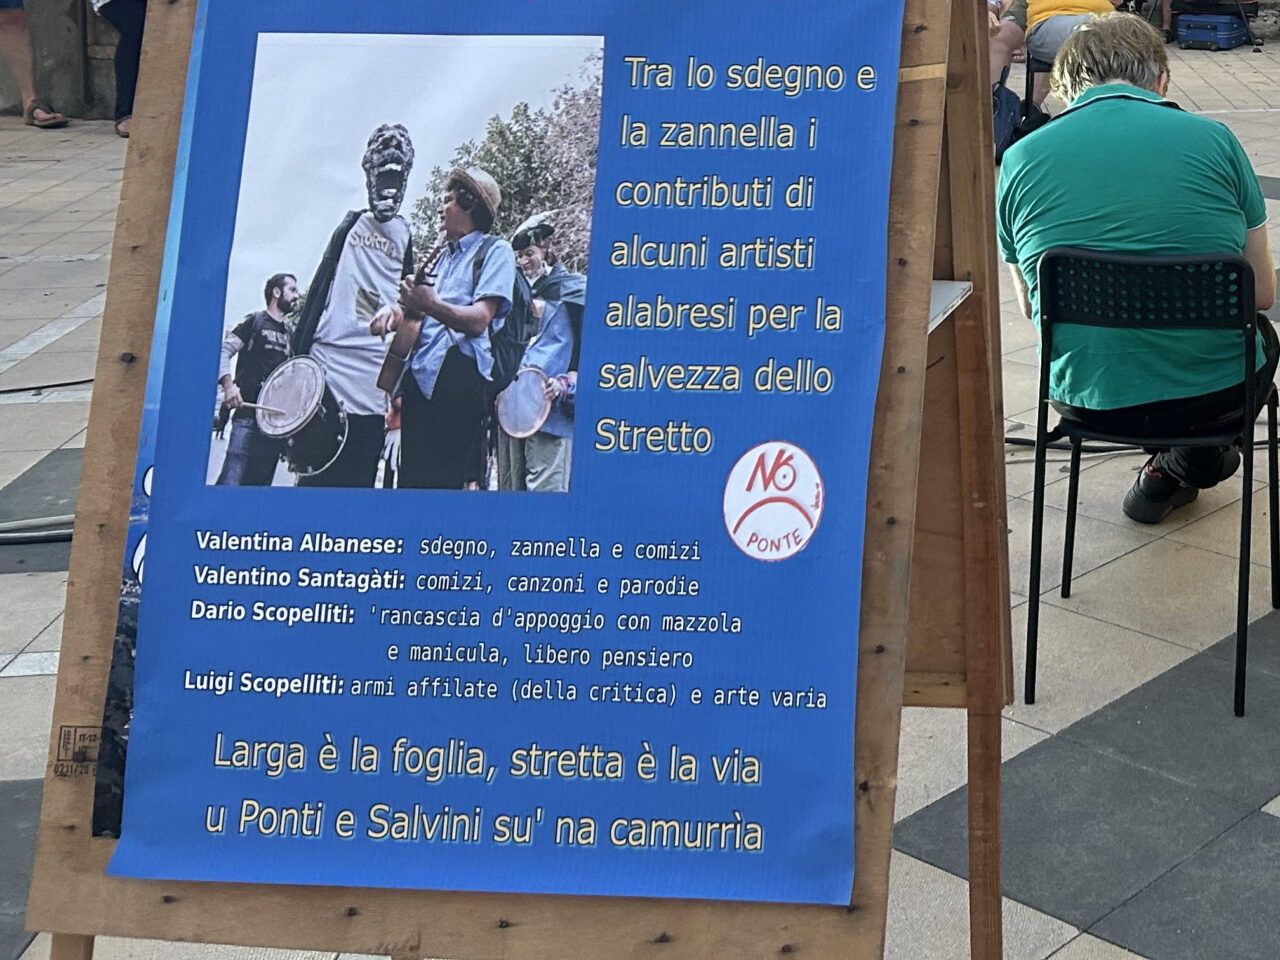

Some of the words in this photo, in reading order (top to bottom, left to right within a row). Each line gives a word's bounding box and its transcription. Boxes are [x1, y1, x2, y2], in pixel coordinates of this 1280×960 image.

[624, 57, 673, 88] Tra
[687, 56, 715, 88] lo
[726, 57, 845, 97] sdegno
[856, 65, 877, 90] e
[620, 114, 648, 147] la
[659, 115, 795, 149] zannella
[807, 117, 818, 149] i
[615, 174, 774, 208] contributi
[784, 175, 816, 209] di
[609, 234, 708, 268] alcuni
[718, 236, 816, 270] artisti
[605, 294, 737, 330] alabresi
[747, 304, 805, 338] per
[814, 297, 842, 331] la
[598, 356, 741, 391] salvezza
[753, 358, 834, 393] dello
[594, 417, 713, 454] Stretto
[746, 448, 796, 492] NO
[196, 530, 293, 553] Valentina
[299, 533, 404, 555] Albanese:
[419, 536, 498, 559] sdegno,
[510, 537, 601, 559] zannella
[611, 545, 624, 559] e
[634, 540, 702, 561] comizi
[746, 528, 803, 552] PONTE
[194, 565, 291, 587] Valentino
[297, 567, 406, 593] Santagàti:
[416, 570, 495, 594] comizi,
[507, 573, 586, 594] canzoni
[597, 581, 610, 594] e
[619, 575, 700, 599] parodie
[190, 600, 246, 621] Dario
[251, 602, 356, 626] Scopelliti:
[370, 605, 481, 627] 'rancascia
[491, 606, 606, 634] d'appoggio
[616, 616, 651, 631] con
[661, 612, 743, 633] mazzola
[387, 645, 400, 661] e
[409, 642, 510, 666] manicula,
[523, 643, 592, 666] libero
[601, 647, 695, 670] pensiero
[184, 671, 234, 694] Luigi
[240, 673, 345, 698] Scopelliti:
[351, 675, 396, 697] armi
[407, 677, 499, 699] affilate
[510, 678, 578, 702] (della
[589, 682, 679, 707] critica)
[690, 690, 703, 706] e
[713, 687, 761, 707] arte
[771, 687, 829, 709] varia
[213, 732, 307, 778] Larga
[317, 733, 339, 772] è
[350, 736, 380, 774] la
[391, 737, 496, 784] foglia,
[509, 744, 625, 780] stretta
[636, 741, 658, 782] è
[669, 745, 698, 783] la
[711, 748, 762, 785] via
[205, 804, 226, 835] u
[238, 799, 325, 838] Ponti
[334, 810, 356, 839] e
[367, 803, 483, 844] Salvini
[493, 807, 545, 846] su'
[554, 816, 598, 847] na
[609, 811, 764, 852] camurrìa
